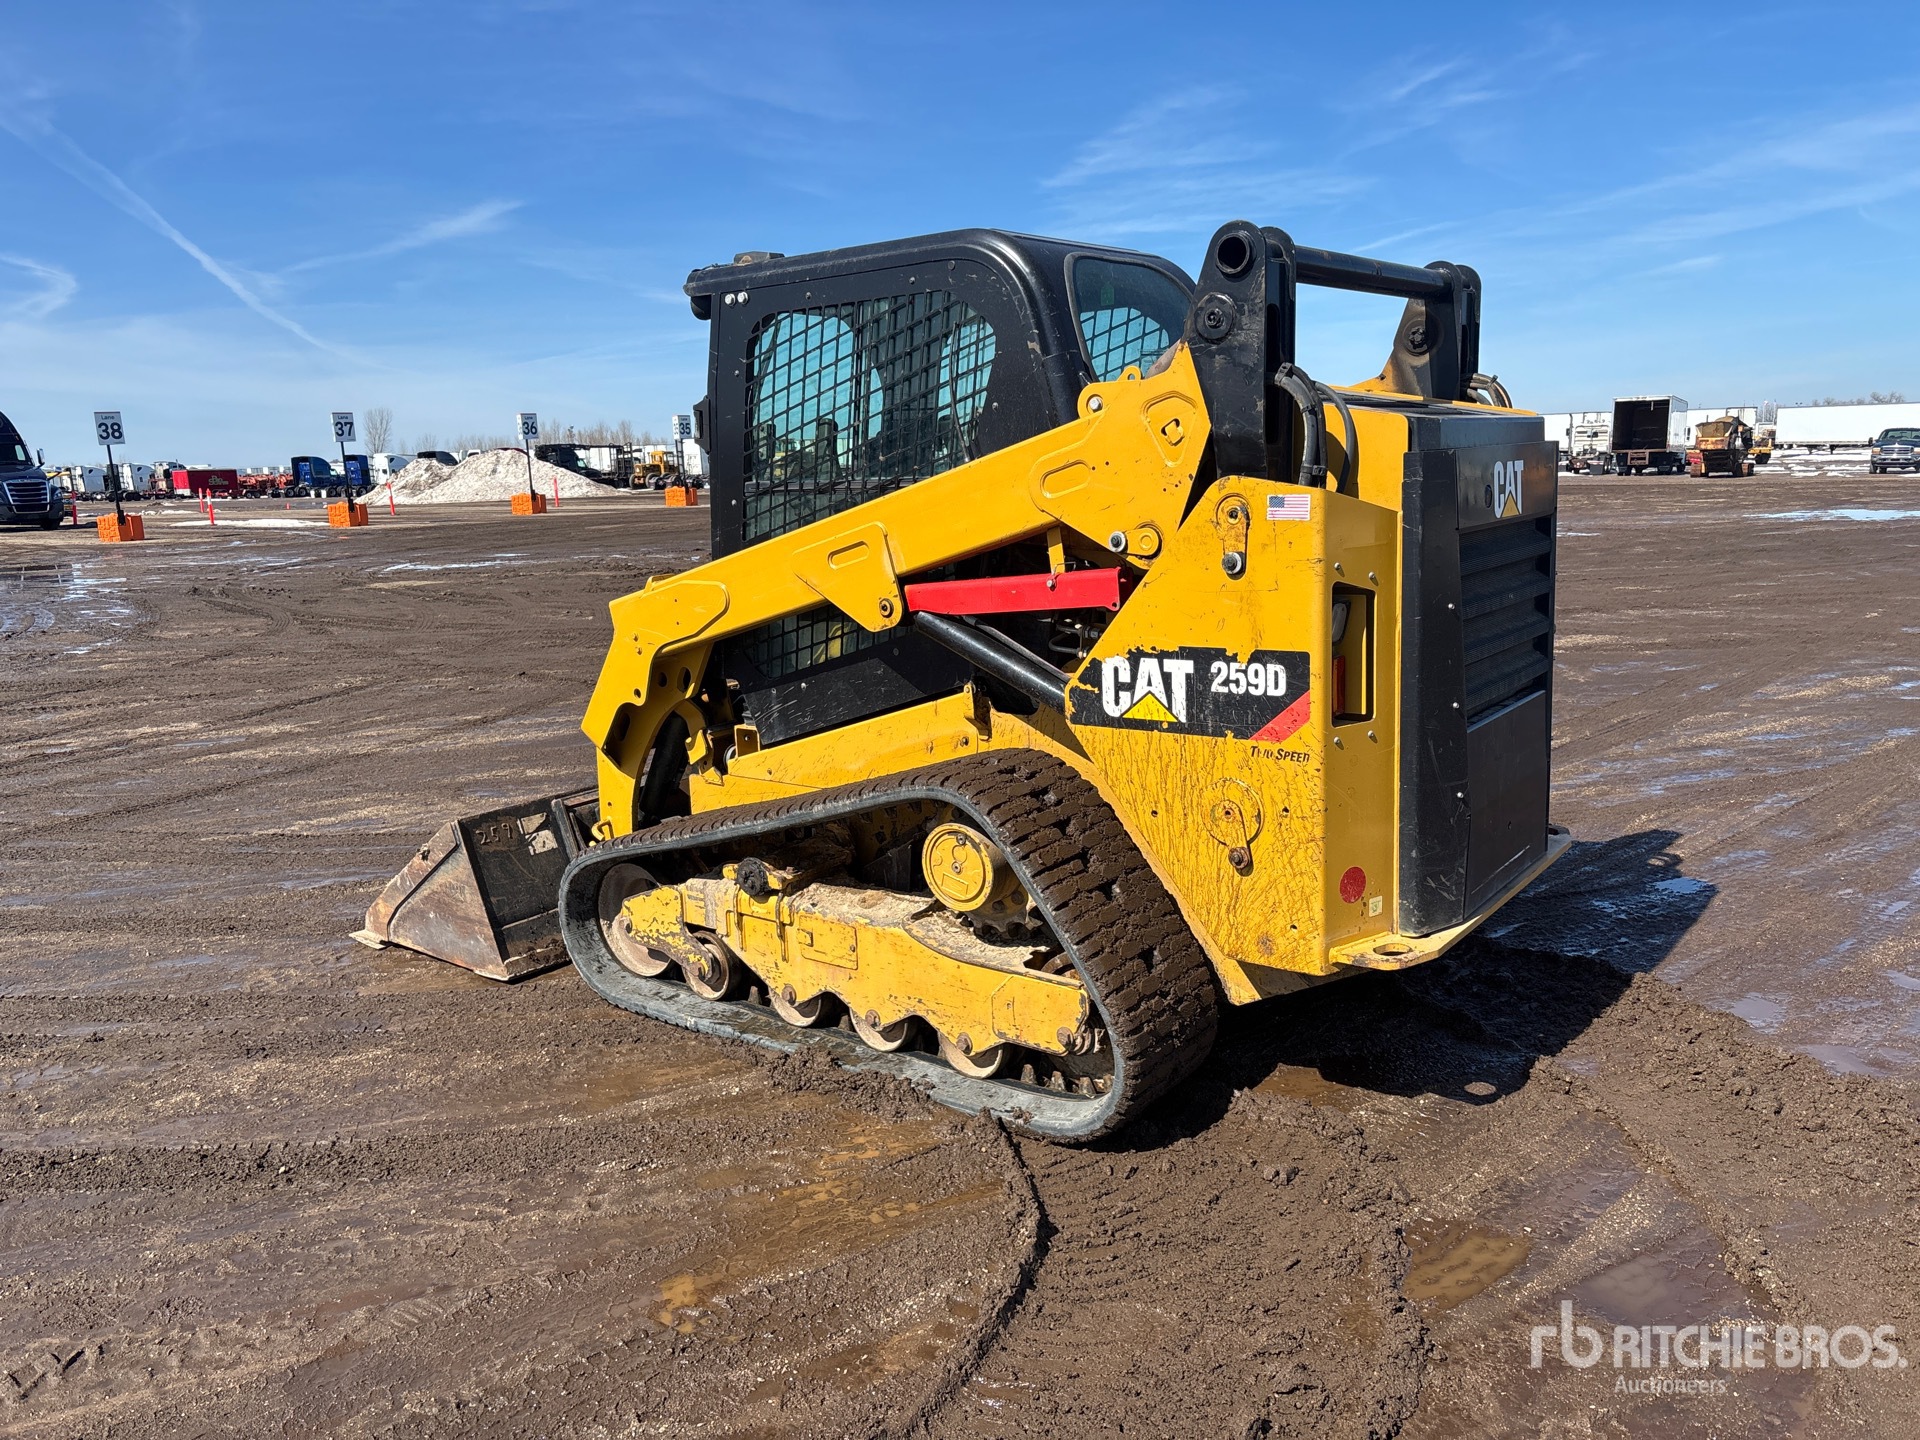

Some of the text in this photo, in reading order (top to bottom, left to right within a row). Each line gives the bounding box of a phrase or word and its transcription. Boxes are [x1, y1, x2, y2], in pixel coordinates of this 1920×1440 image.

[98, 422, 123, 440] 38
[335, 421, 353, 437] 37
[522, 421, 538, 435] 36
[679, 422, 691, 435] 35
[1493, 460, 1524, 519] CAT
[1101, 655, 1287, 723] CAT 259D
[475, 823, 512, 844] 259
